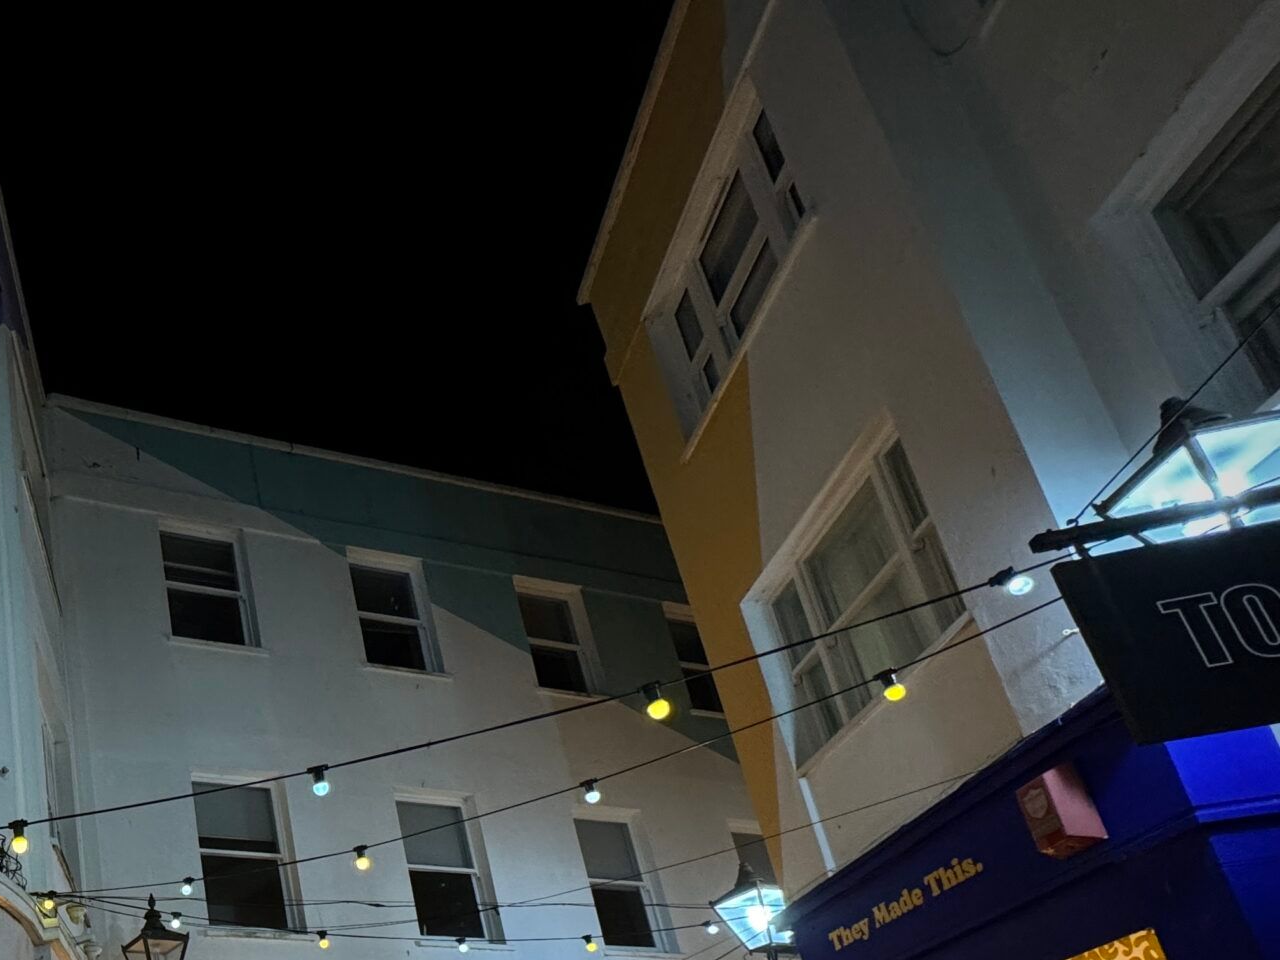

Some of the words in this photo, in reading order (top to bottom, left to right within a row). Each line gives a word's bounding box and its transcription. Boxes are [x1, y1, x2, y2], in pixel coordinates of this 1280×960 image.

[828, 917, 870, 951] They
[872, 887, 924, 928] Made
[923, 857, 984, 897] This.
